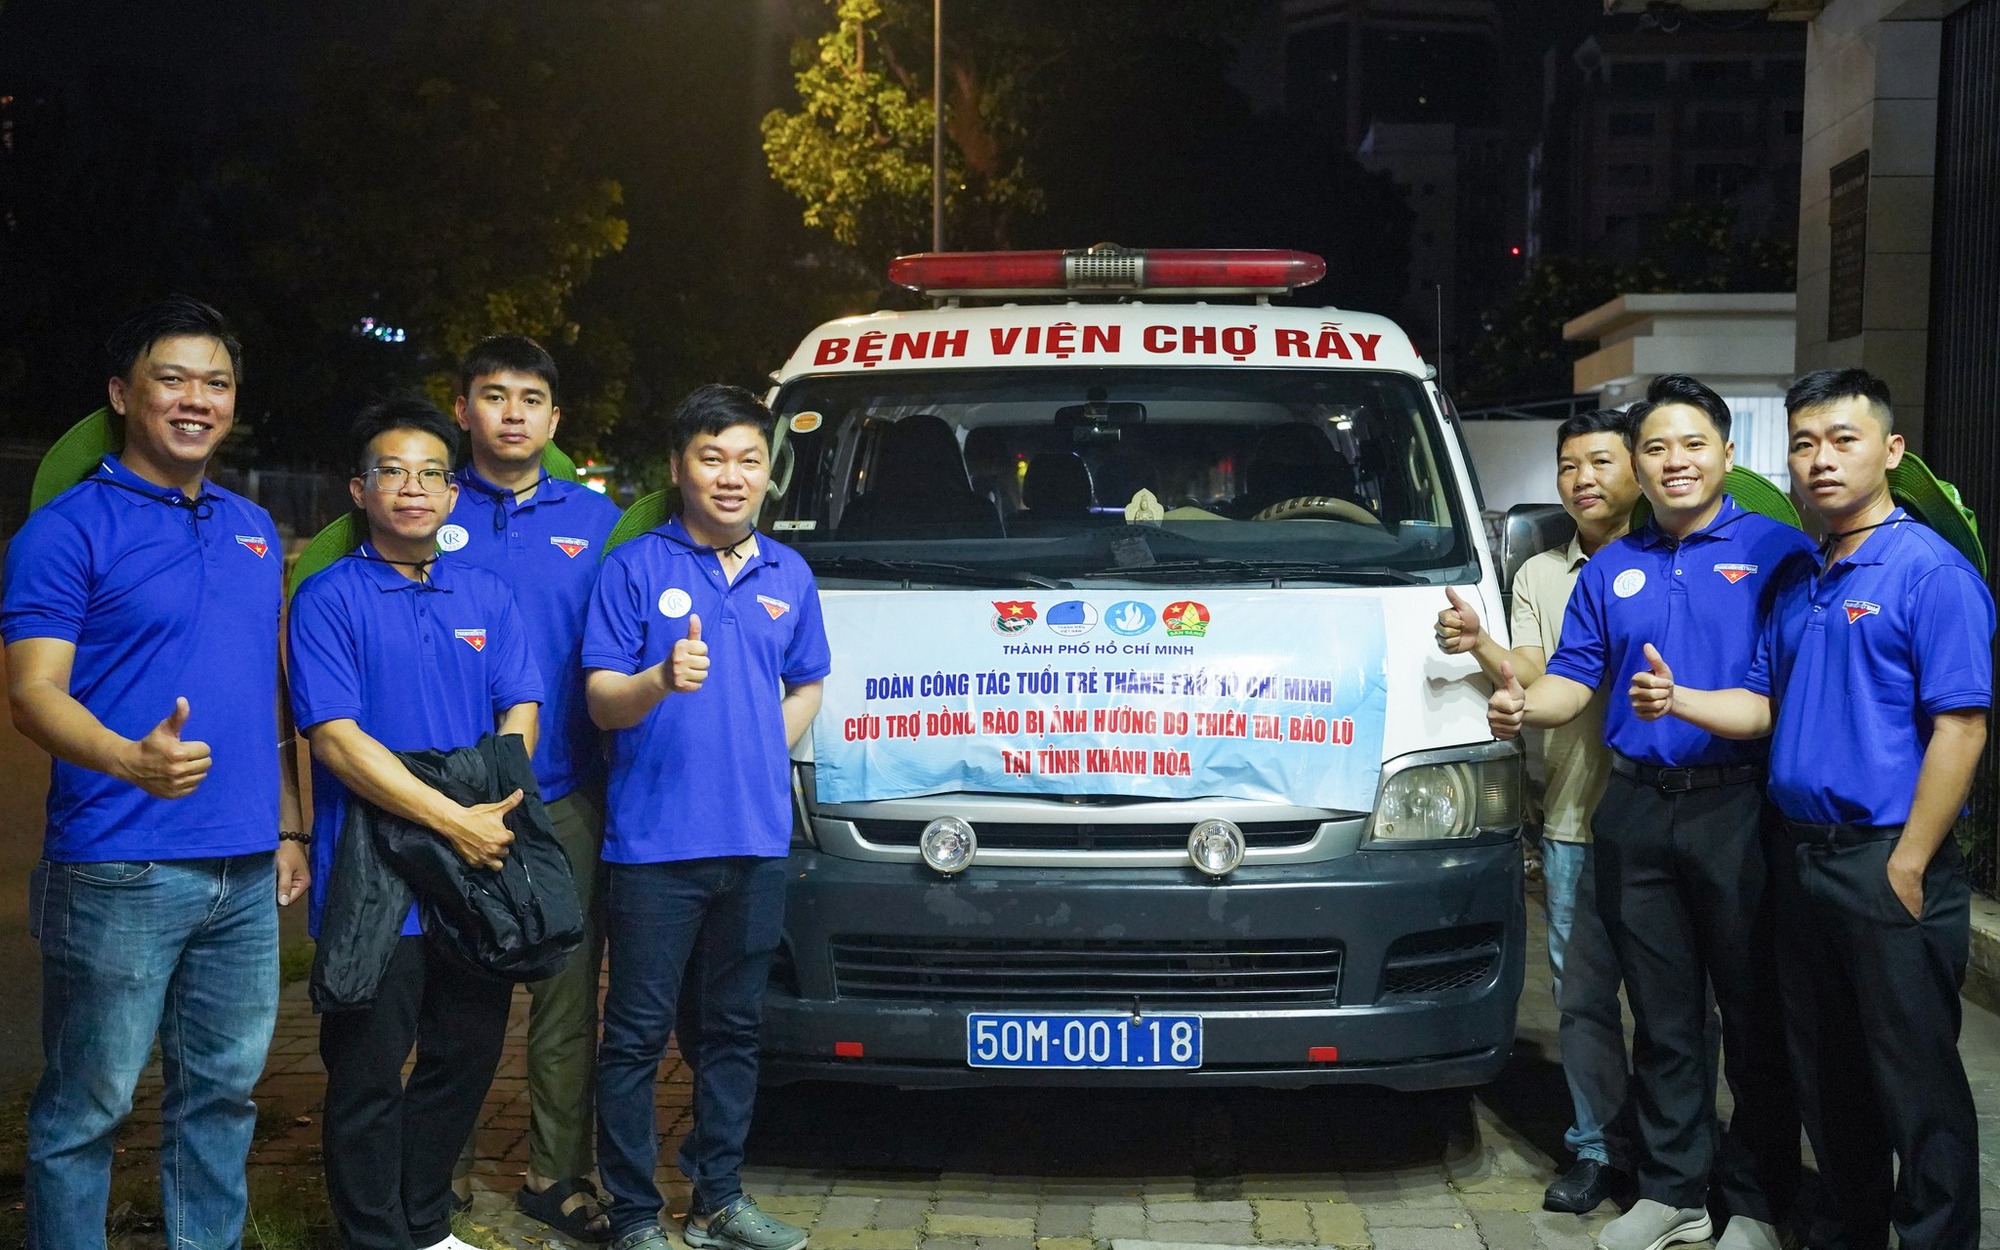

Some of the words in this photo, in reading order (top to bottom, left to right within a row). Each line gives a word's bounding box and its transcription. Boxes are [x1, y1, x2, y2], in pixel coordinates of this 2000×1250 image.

[813, 330, 968, 368] BỆNH
[991, 322, 1121, 359] VIỆN
[1143, 324, 1258, 362] CHỢ
[1275, 322, 1382, 361] RẪY
[1003, 642, 1053, 655] THÀNH
[1058, 641, 1090, 654] PHỐ
[1095, 640, 1117, 654] HỒ
[1122, 642, 1149, 655] CHÍ
[1155, 645, 1194, 656] MINH
[866, 674, 914, 700] ĐOÀN
[921, 671, 969, 697] CÔNG
[976, 669, 1010, 695] TÁC
[1017, 664, 1059, 694] TUỔI
[1065, 667, 1098, 693] TRẺ
[1104, 669, 1164, 694] THÀNH
[1284, 678, 1331, 702] MINH
[844, 712, 880, 741] CỨU
[886, 711, 921, 741] TRỢ
[927, 705, 976, 736] ĐỒNG
[983, 708, 1019, 734] BÀO
[1026, 711, 1044, 738] BỊ
[1050, 705, 1087, 733] ẢNH
[1094, 705, 1157, 733] HƯỞNG
[1163, 711, 1188, 736] DO
[1195, 710, 1246, 738] THIÊN
[1253, 715, 1283, 742] TAI,
[1290, 714, 1325, 743] BÃO
[1333, 718, 1354, 745] LŨ
[1002, 751, 1031, 777] TẠI
[1037, 745, 1080, 774] TỈNH
[1086, 747, 1147, 774] KHÁNH
[1153, 749, 1191, 776] HÒA
[977, 1020, 1192, 1062] 50M-001.18
